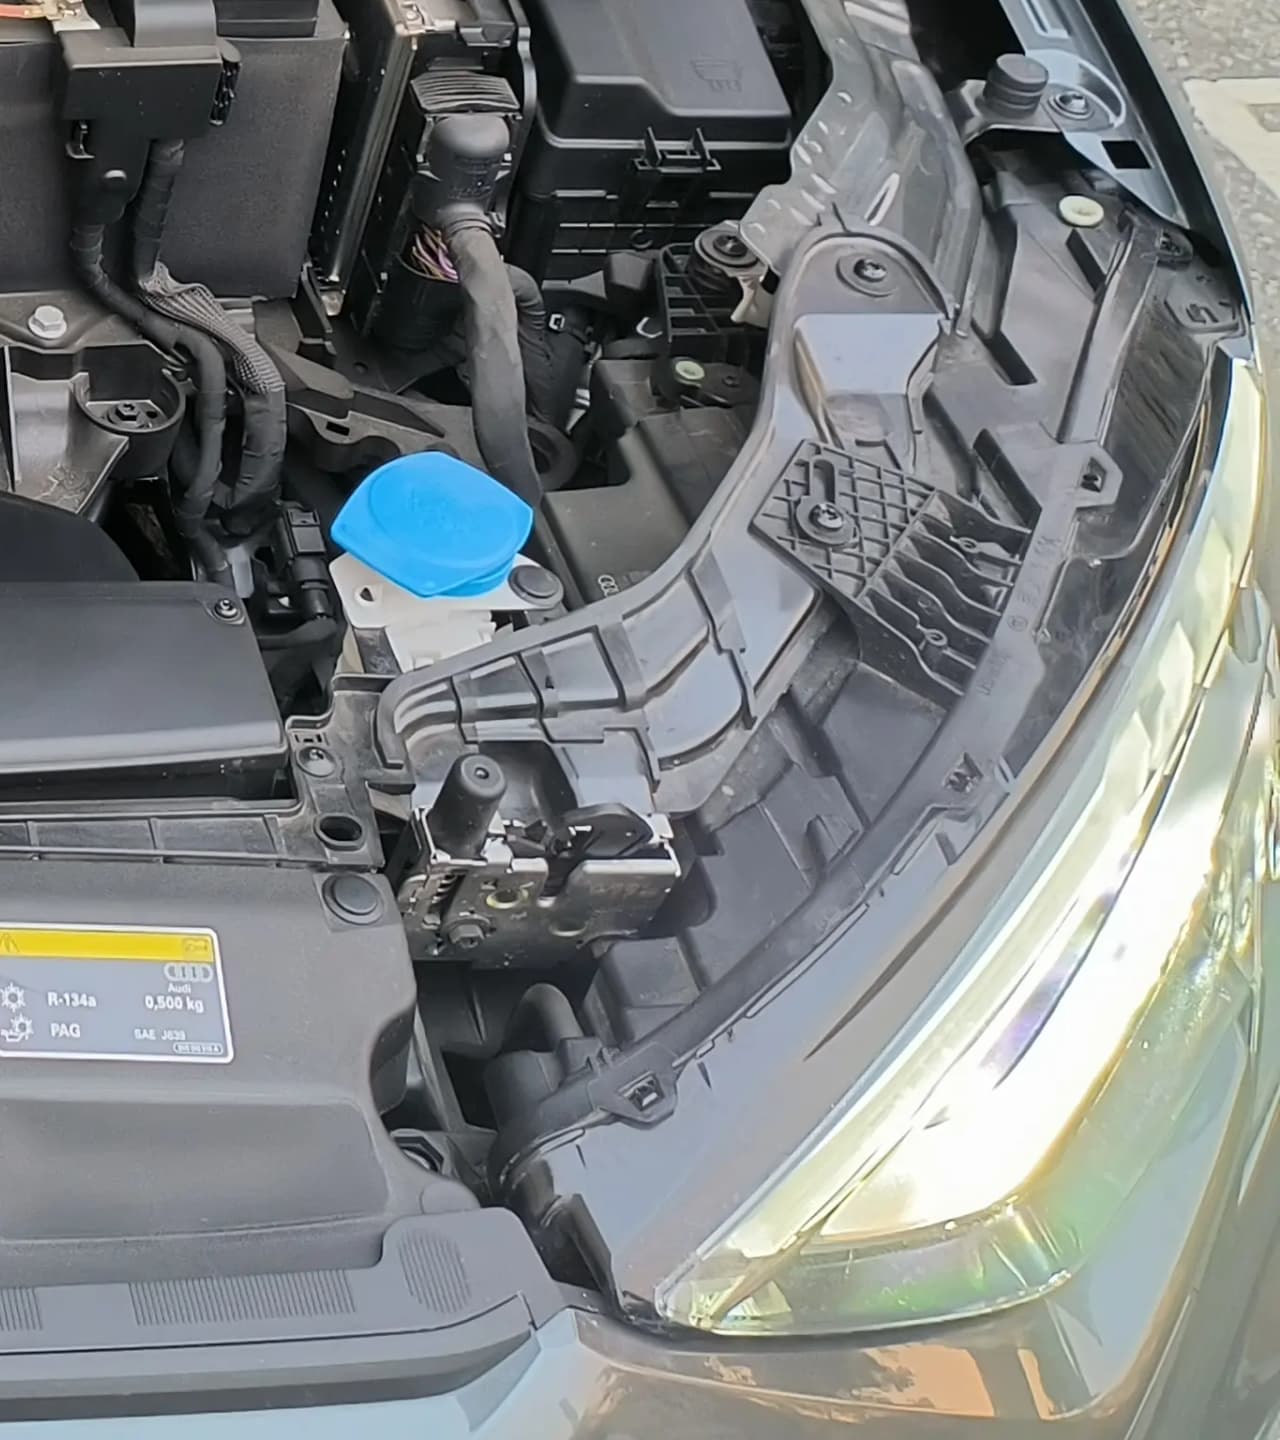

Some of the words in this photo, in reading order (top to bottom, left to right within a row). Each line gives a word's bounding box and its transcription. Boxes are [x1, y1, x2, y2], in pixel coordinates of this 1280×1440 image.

[168, 983, 192, 993] Audi
[47, 991, 97, 1007] R-134a
[145, 995, 183, 1010] 0,500
[186, 996, 205, 1013] kg
[50, 1023, 81, 1038] PAG
